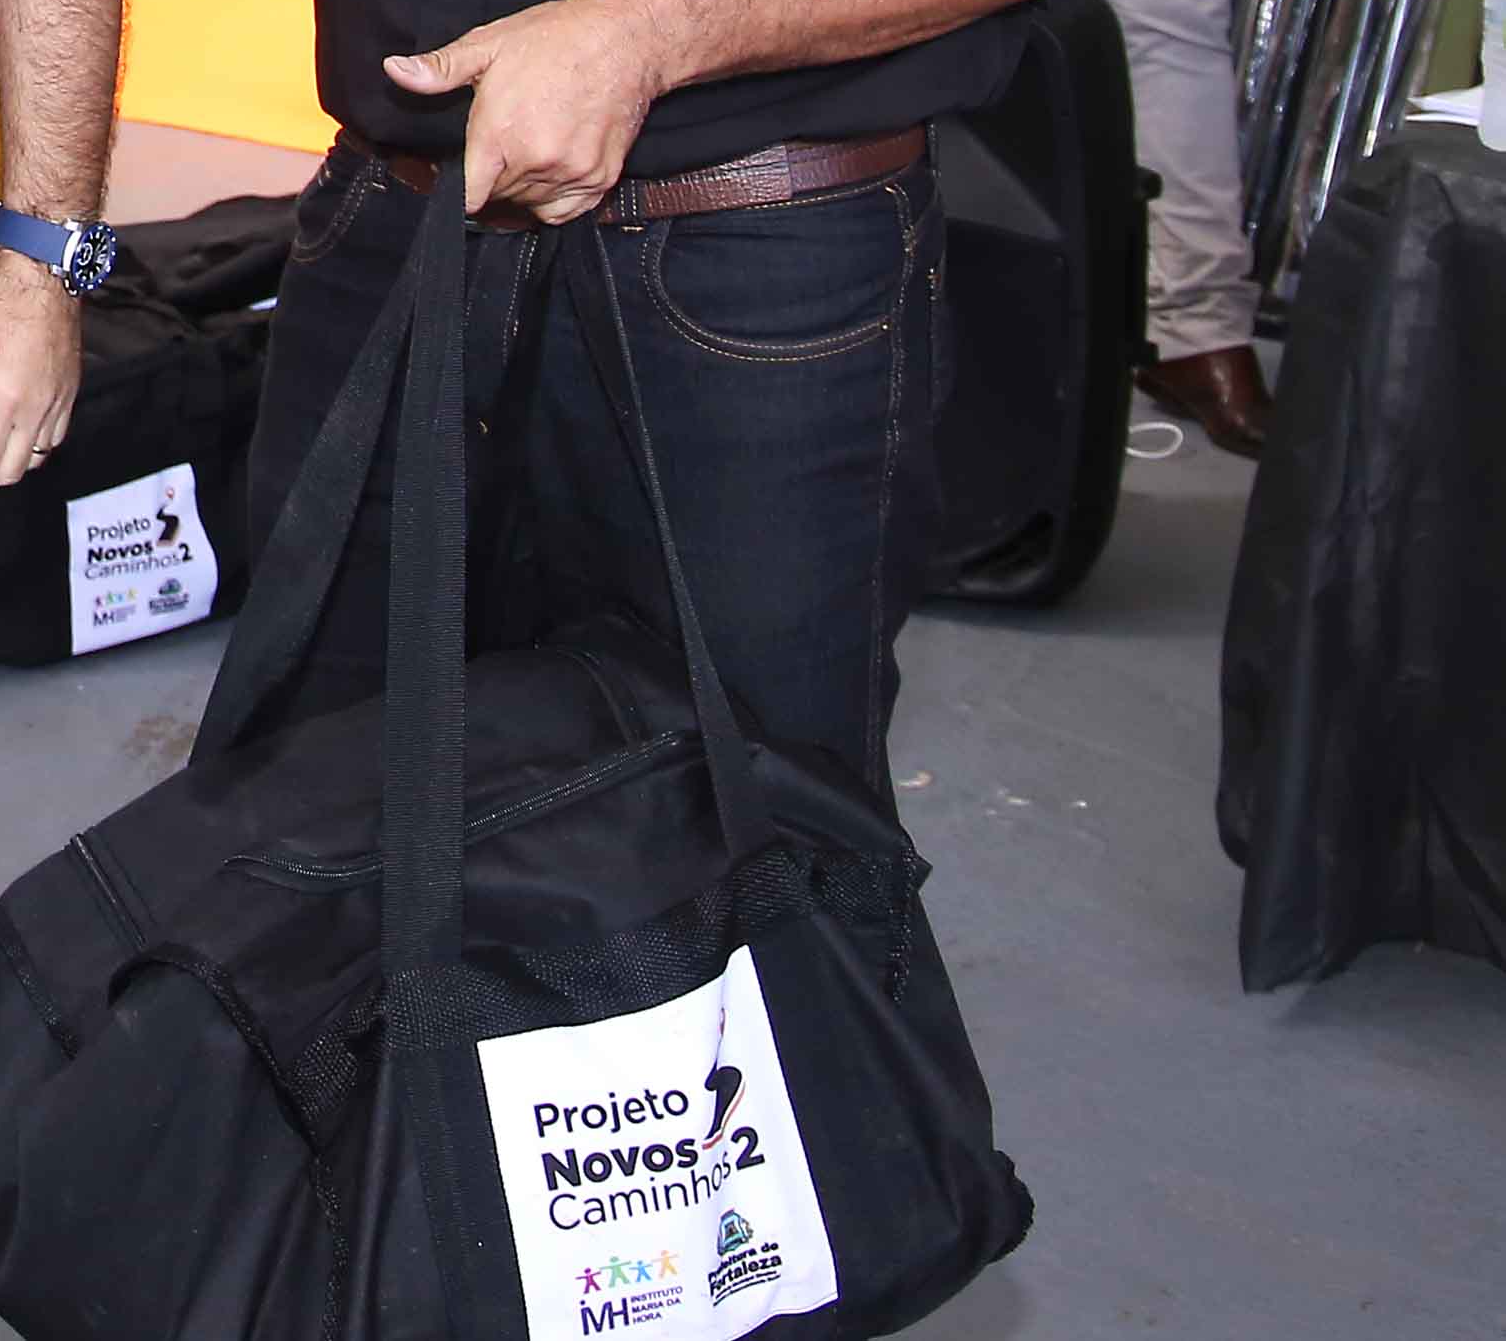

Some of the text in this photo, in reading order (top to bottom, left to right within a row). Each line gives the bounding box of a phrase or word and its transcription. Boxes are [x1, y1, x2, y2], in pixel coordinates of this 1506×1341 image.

[87, 518, 151, 543] Projeto
[85, 543, 193, 580] Caminhos 2
[87, 540, 154, 564] Novos
[533, 1089, 689, 1138] Projeto
[541, 1138, 699, 1191] Novos
[548, 1127, 766, 1230] Caminhos 2
[630, 1286, 683, 1303] INSTITUTO
[631, 1297, 681, 1314] MARIA DA
[633, 1312, 662, 1324] HORA
